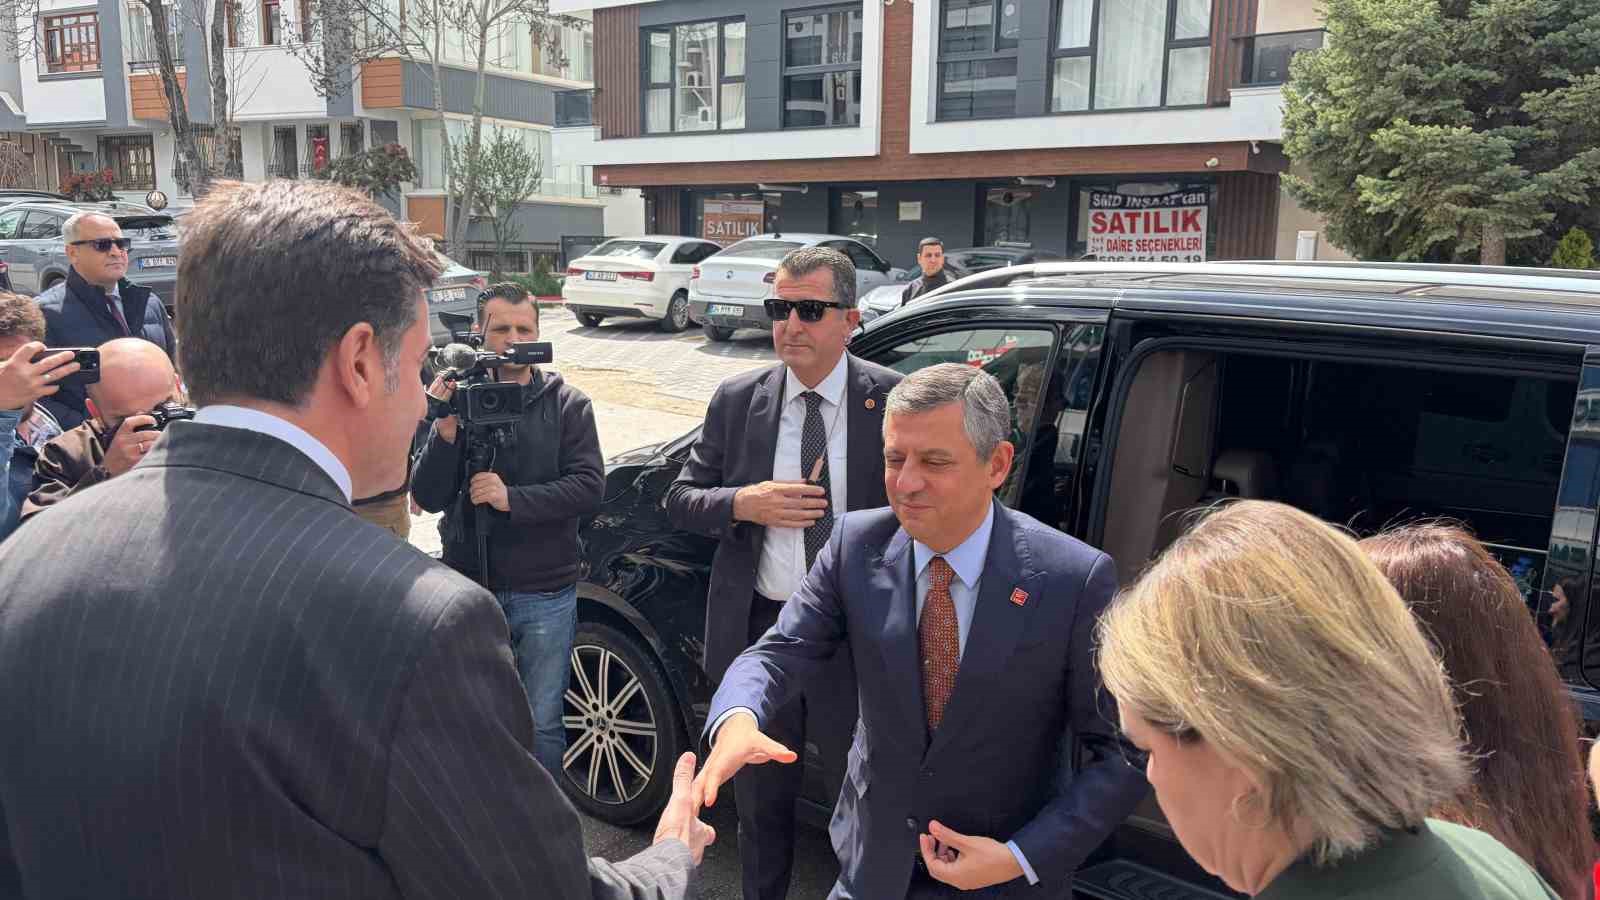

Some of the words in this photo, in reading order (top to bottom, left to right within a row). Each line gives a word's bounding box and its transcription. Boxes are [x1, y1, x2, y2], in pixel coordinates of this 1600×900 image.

[707, 220, 760, 237] SATILIK
[1091, 208, 1202, 234] SATILIK
[1106, 236, 1134, 252] DAİRE
